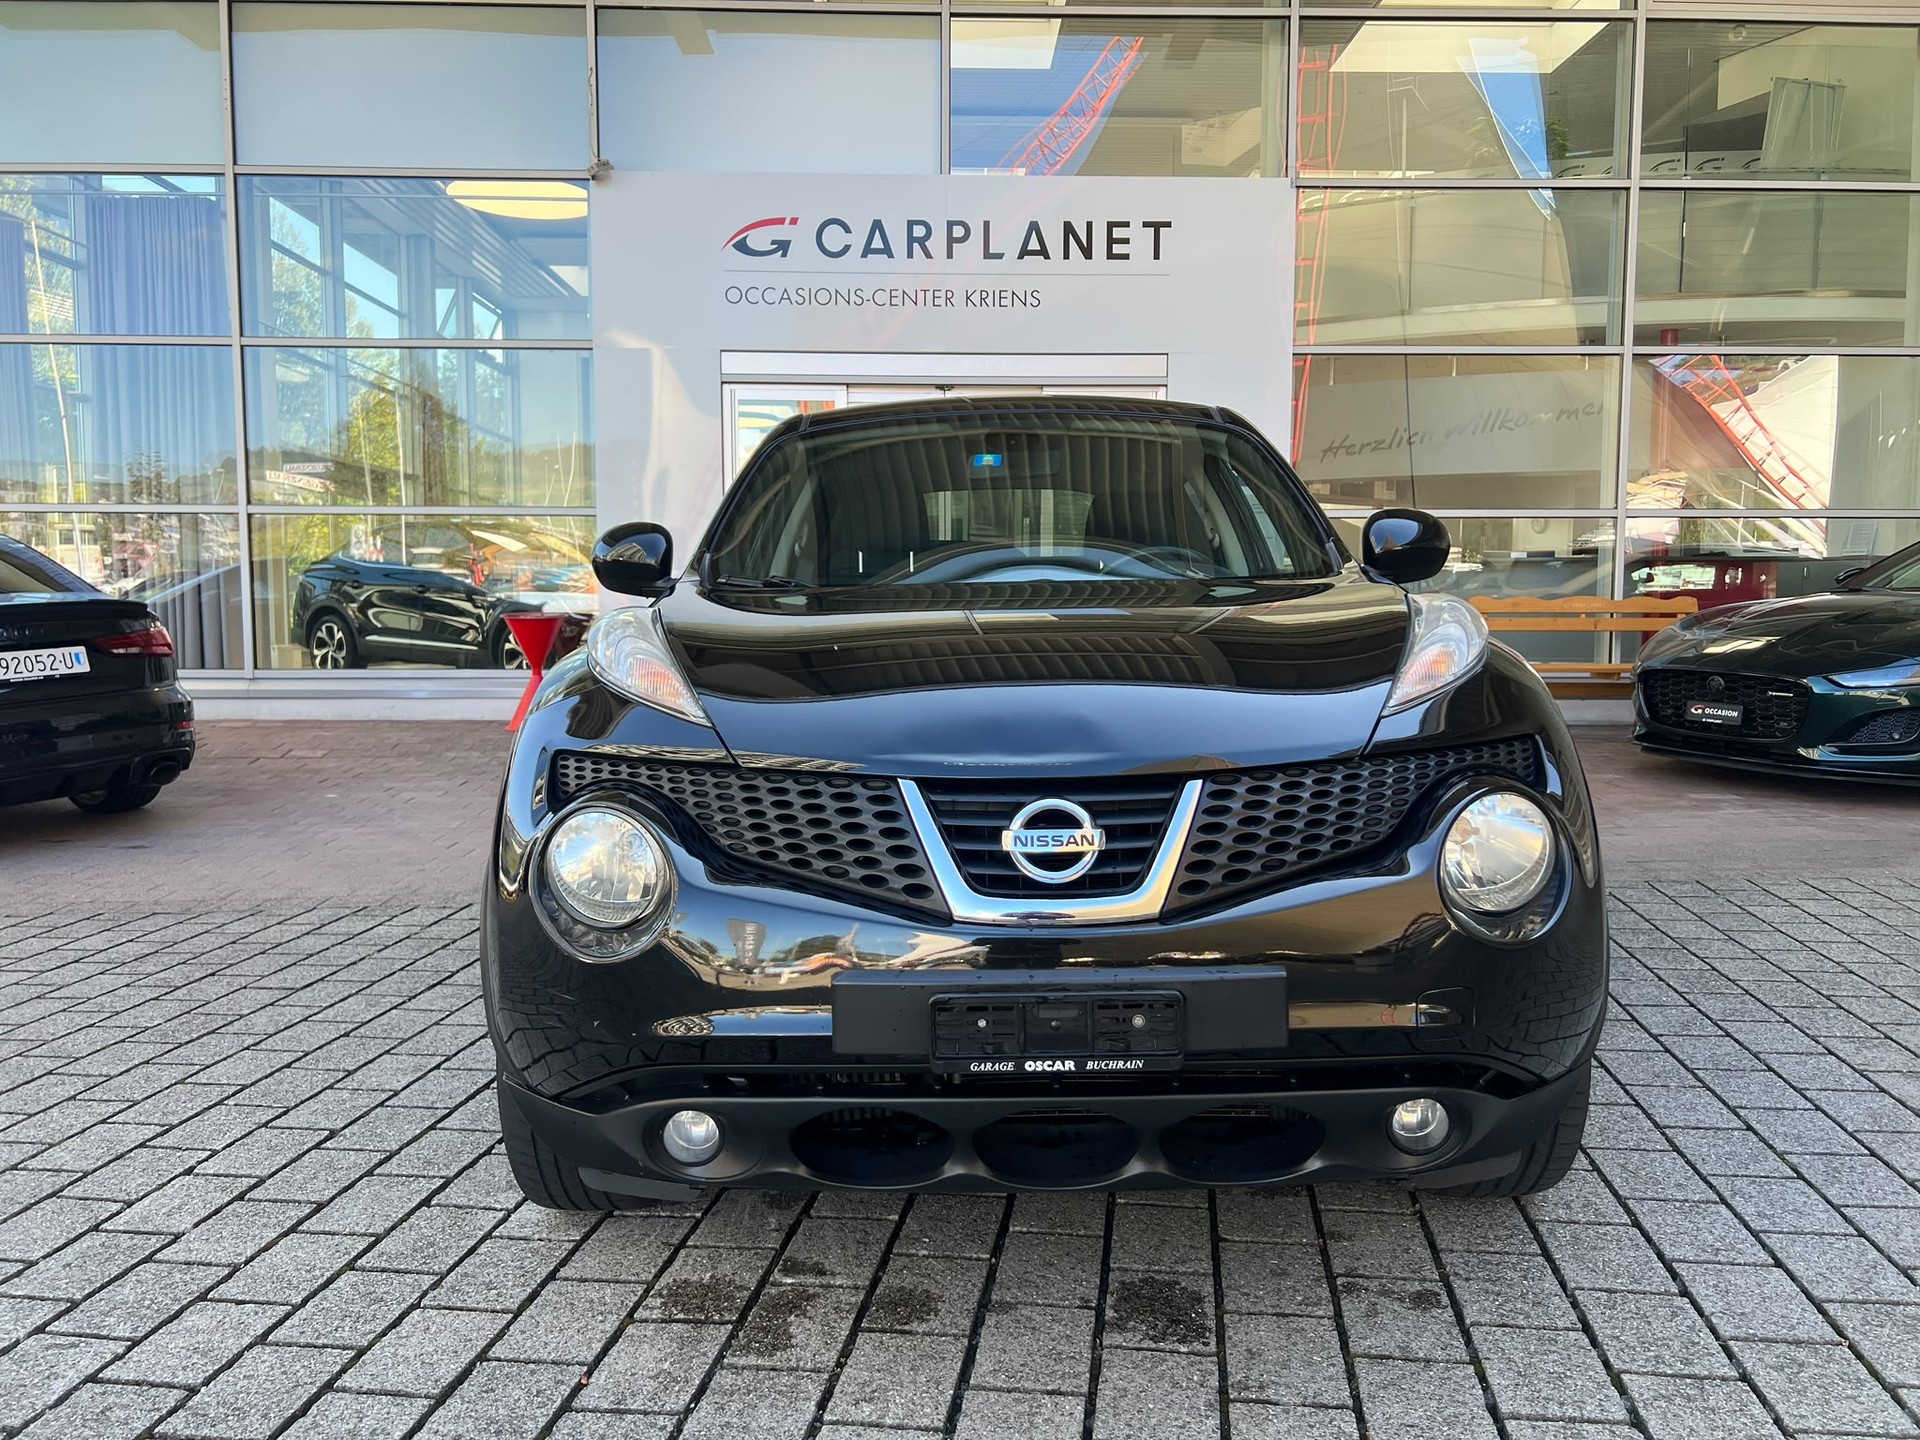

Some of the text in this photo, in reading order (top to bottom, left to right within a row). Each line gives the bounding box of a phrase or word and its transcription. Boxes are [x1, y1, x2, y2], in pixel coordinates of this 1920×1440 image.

[815, 217, 1173, 261] CARPLANET
[724, 286, 1042, 308] OCCASIONS-CENTER KRIENS
[1704, 707, 1738, 718] OCCASION
[1013, 834, 1095, 848] NISSAN
[969, 1059, 1144, 1072] GARAGE OSCAR BUCHRAIN
